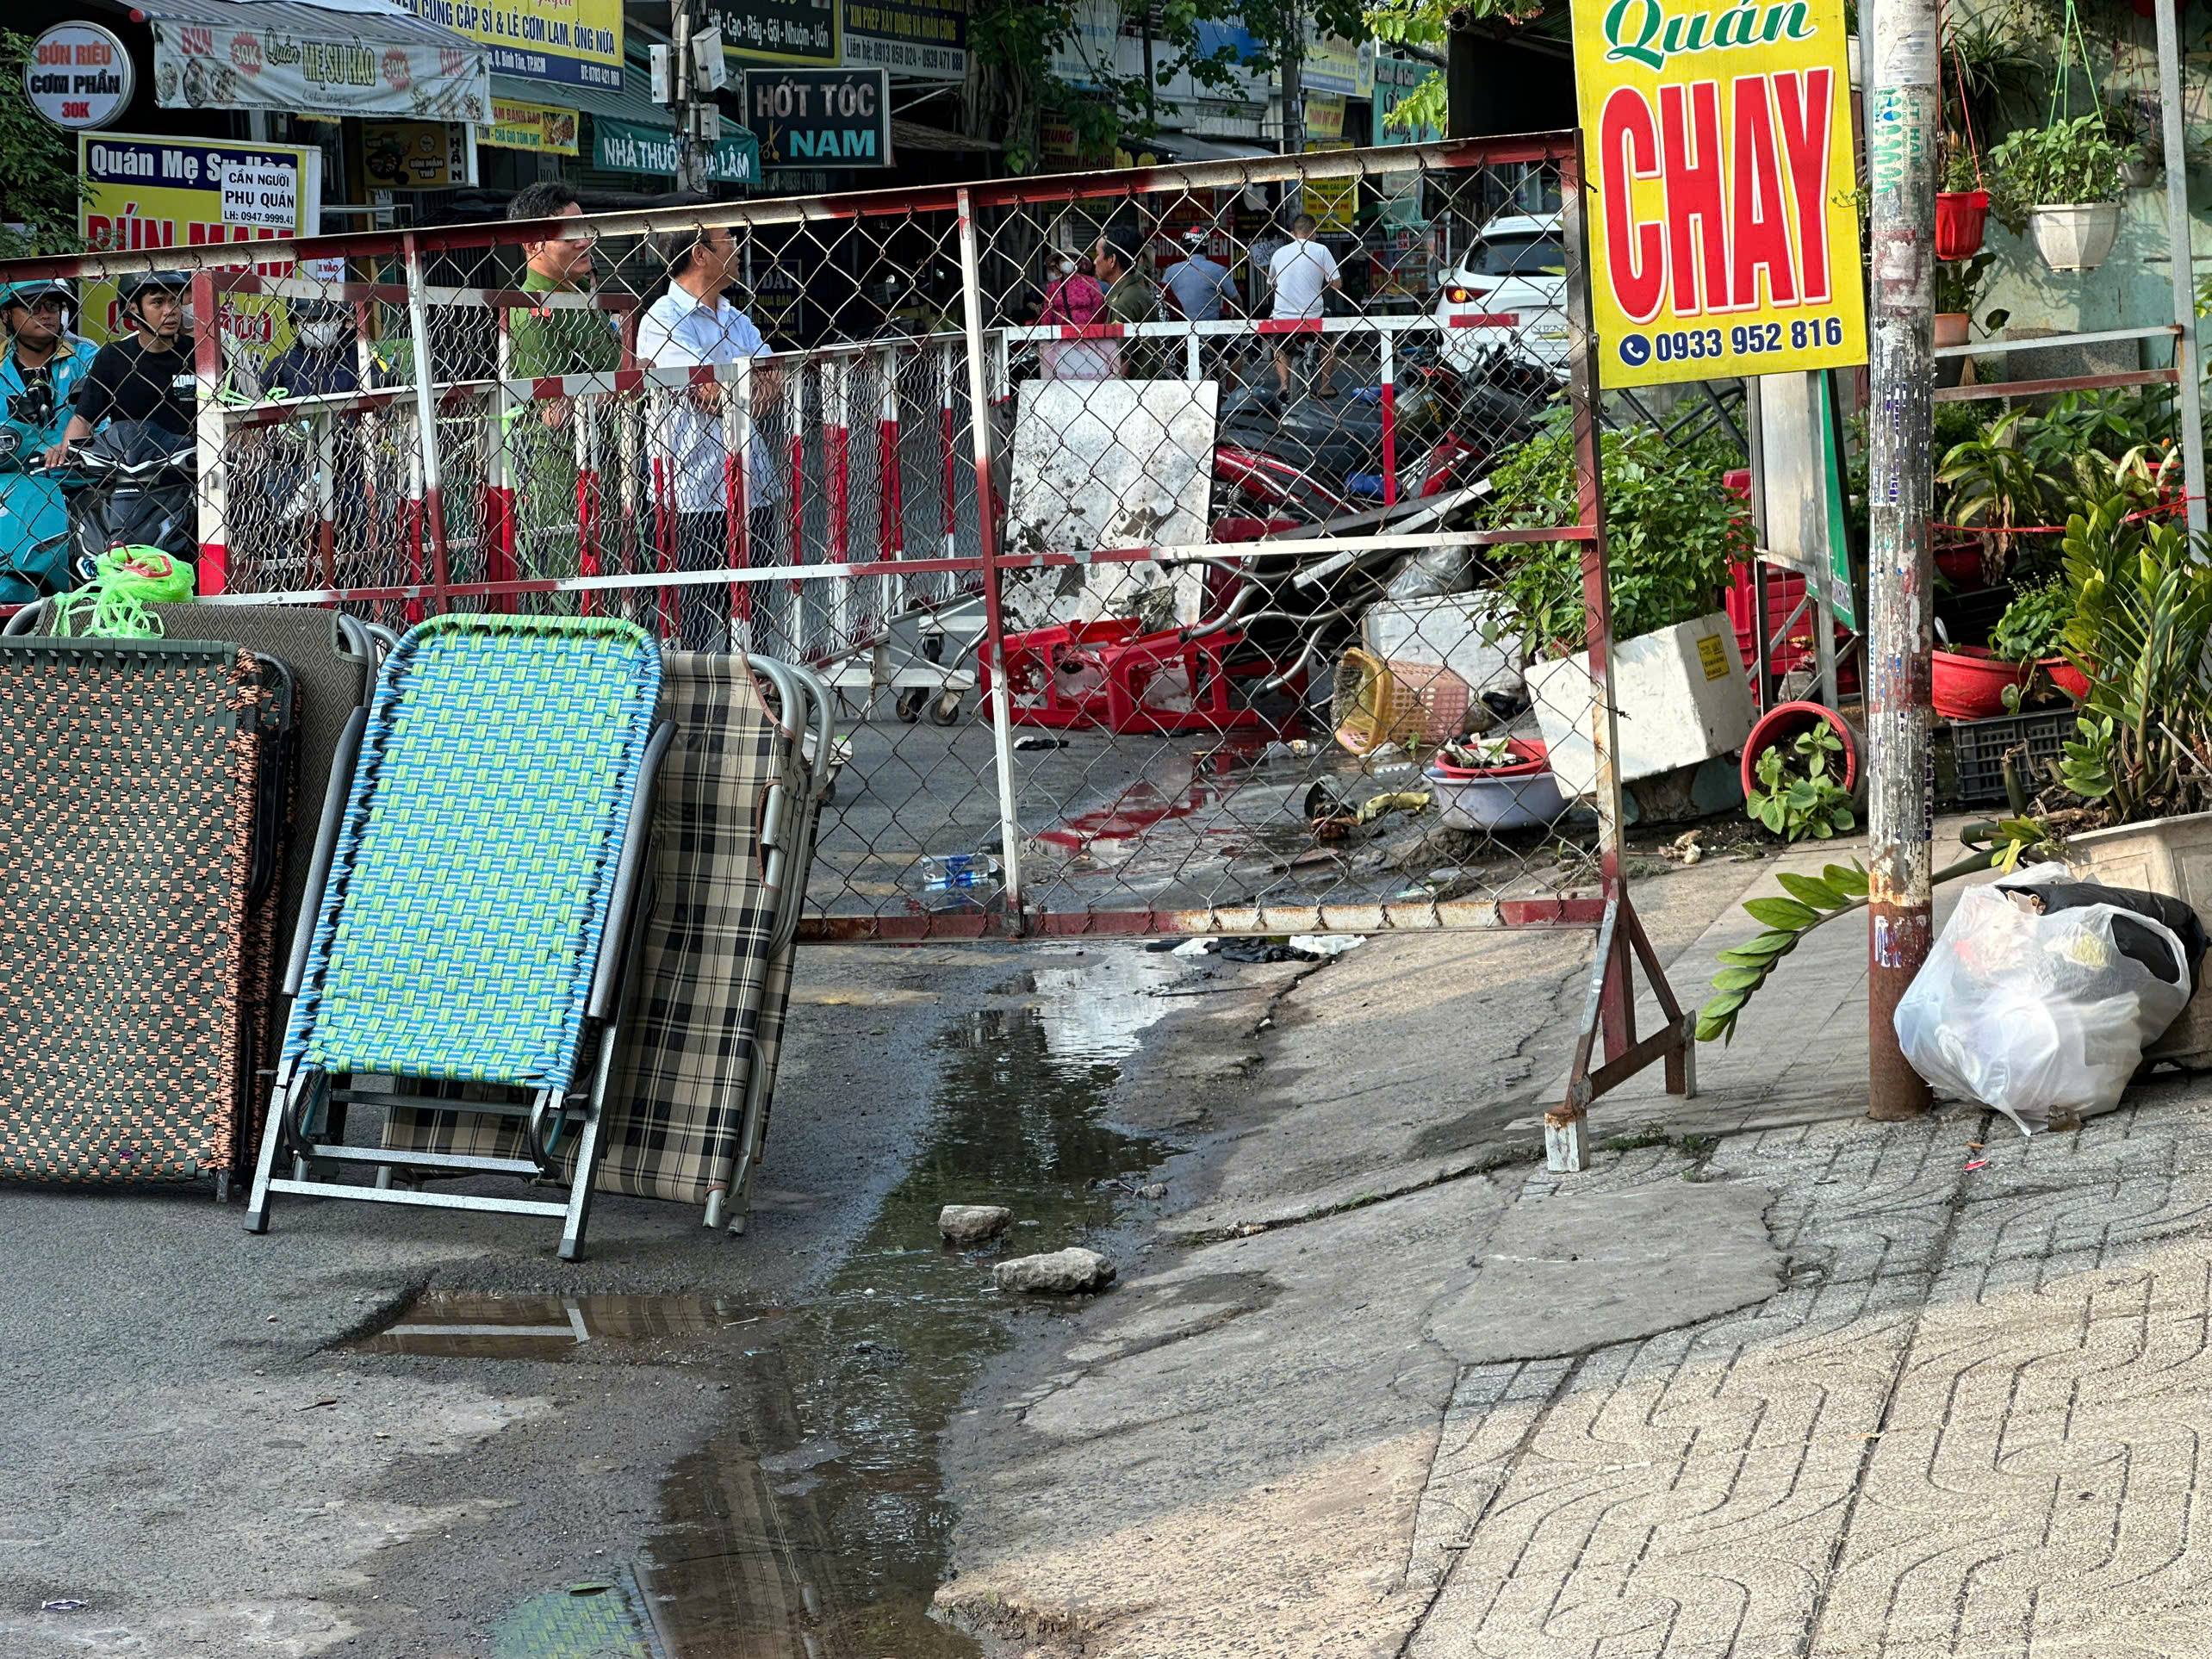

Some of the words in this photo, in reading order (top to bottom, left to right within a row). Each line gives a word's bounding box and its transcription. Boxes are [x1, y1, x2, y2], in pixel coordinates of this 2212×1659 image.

[422, 0, 453, 26] CUNG
[457, 0, 478, 30] CẤP
[496, 11, 504, 34] &
[507, 6, 519, 37] LẺ
[522, 16, 544, 41] CƠM
[548, 21, 571, 49] LAM,
[574, 18, 593, 51] ỐNG
[596, 28, 615, 55] NỨA
[727, 11, 742, 42] Cạo
[747, 15, 762, 47] Ráy
[767, 17, 780, 48] Gội
[786, 21, 810, 52] Nhuộm
[814, 21, 829, 48] Uốn
[850, 4, 861, 28] XIN
[863, 3, 879, 31] PHÉP
[881, 5, 893, 33] XÂY
[1605, 0, 1815, 71] Quán
[38, 40, 71, 65] BÚN
[76, 40, 112, 65] RIÊU
[233, 44, 259, 65] 30K
[264, 28, 301, 66] Quán
[301, 41, 326, 90] MẸ
[326, 43, 345, 84] SU
[345, 35, 376, 86] HÀO
[385, 57, 409, 79] 30K
[502, 51, 514, 69] Bình
[515, 53, 527, 72] Tân,
[847, 38, 861, 59] Liên
[862, 40, 873, 65] hệ:
[874, 41, 890, 63] 0913
[892, 44, 904, 65] 859
[904, 46, 916, 66] 024
[923, 48, 937, 68] 0939
[939, 51, 950, 70] 471
[952, 52, 963, 71] 888
[30, 72, 69, 94] CƠM
[73, 68, 121, 94] PHẦN
[755, 76, 811, 117] HỚT
[820, 75, 875, 117] TÓC
[61, 101, 90, 118] 30K
[494, 106, 504, 120] AM
[506, 107, 526, 123] BÁNH
[527, 111, 541, 125] BAO
[603, 132, 637, 167] NHÀ
[638, 132, 677, 172] THUỐ
[790, 129, 875, 158] NAM
[91, 145, 154, 177] Quán
[162, 150, 198, 184] Mẹ
[228, 168, 253, 184] CẦN
[258, 171, 289, 187] NGƯỜI
[720, 145, 749, 178] LÂM
[225, 190, 254, 208] PHỤ
[260, 191, 295, 208] QUÁN
[1600, 67, 1833, 325] CHAY
[224, 210, 239, 221] LH:
[241, 212, 294, 225] 0947.9999.41
[1656, 328, 1722, 362] 0933
[1731, 322, 1782, 355] 952
[1792, 316, 1842, 347] 816
